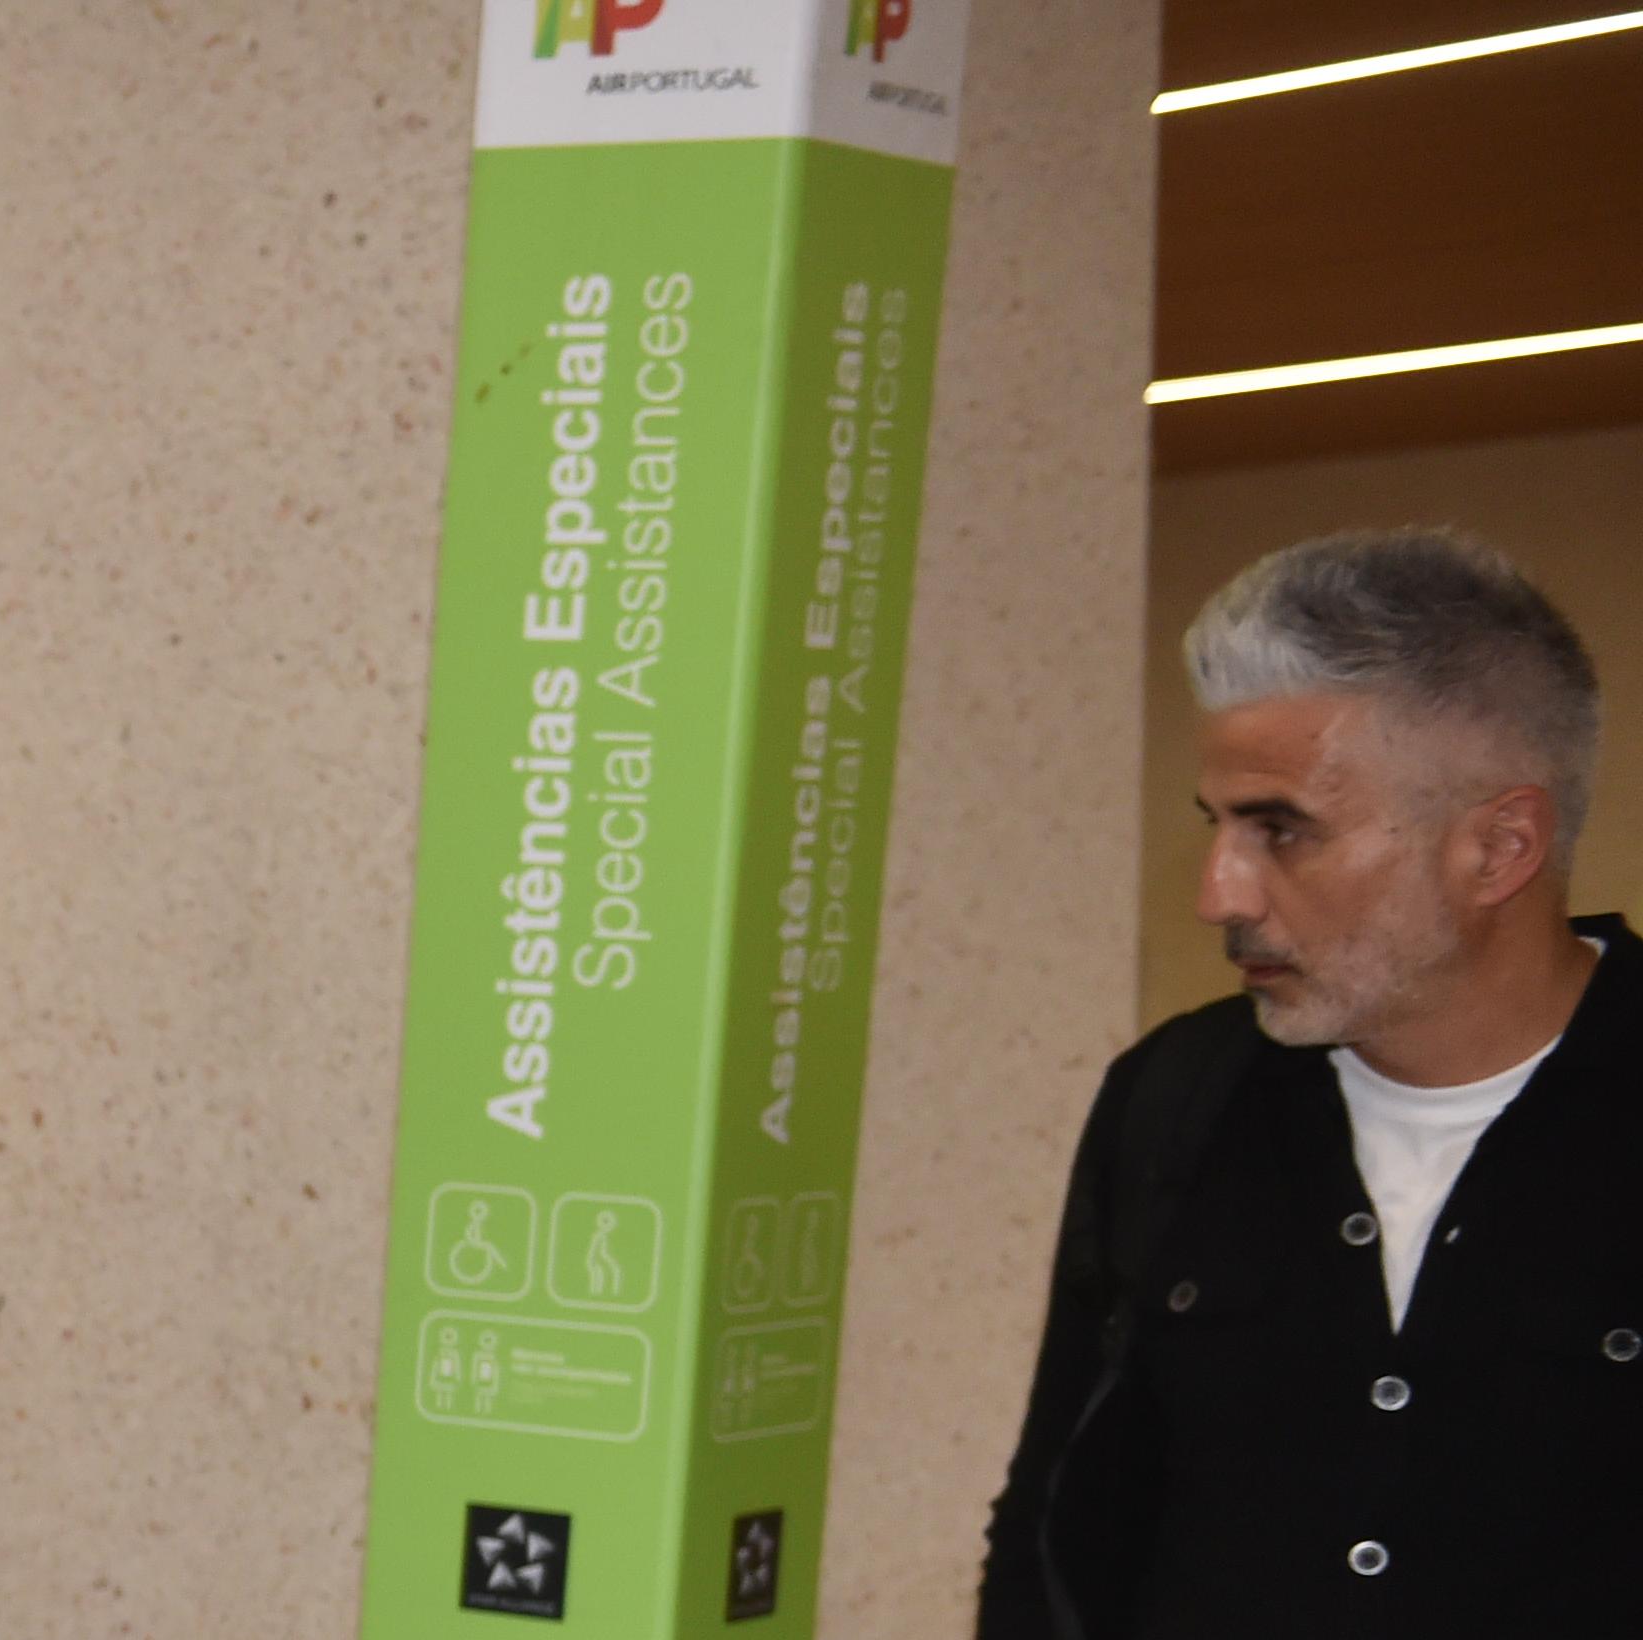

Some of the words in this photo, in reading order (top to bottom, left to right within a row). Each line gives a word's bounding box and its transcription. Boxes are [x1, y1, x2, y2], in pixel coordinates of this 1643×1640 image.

[524, 273, 613, 641] Especiais
[597, 272, 693, 708] Assistances
[805, 739, 866, 992] Special
[838, 288, 908, 715] Assistances
[487, 667, 582, 1140] Assistências
[574, 731, 653, 990] Special
[760, 675, 833, 1145] Assistências
[805, 281, 870, 649] Especiais
